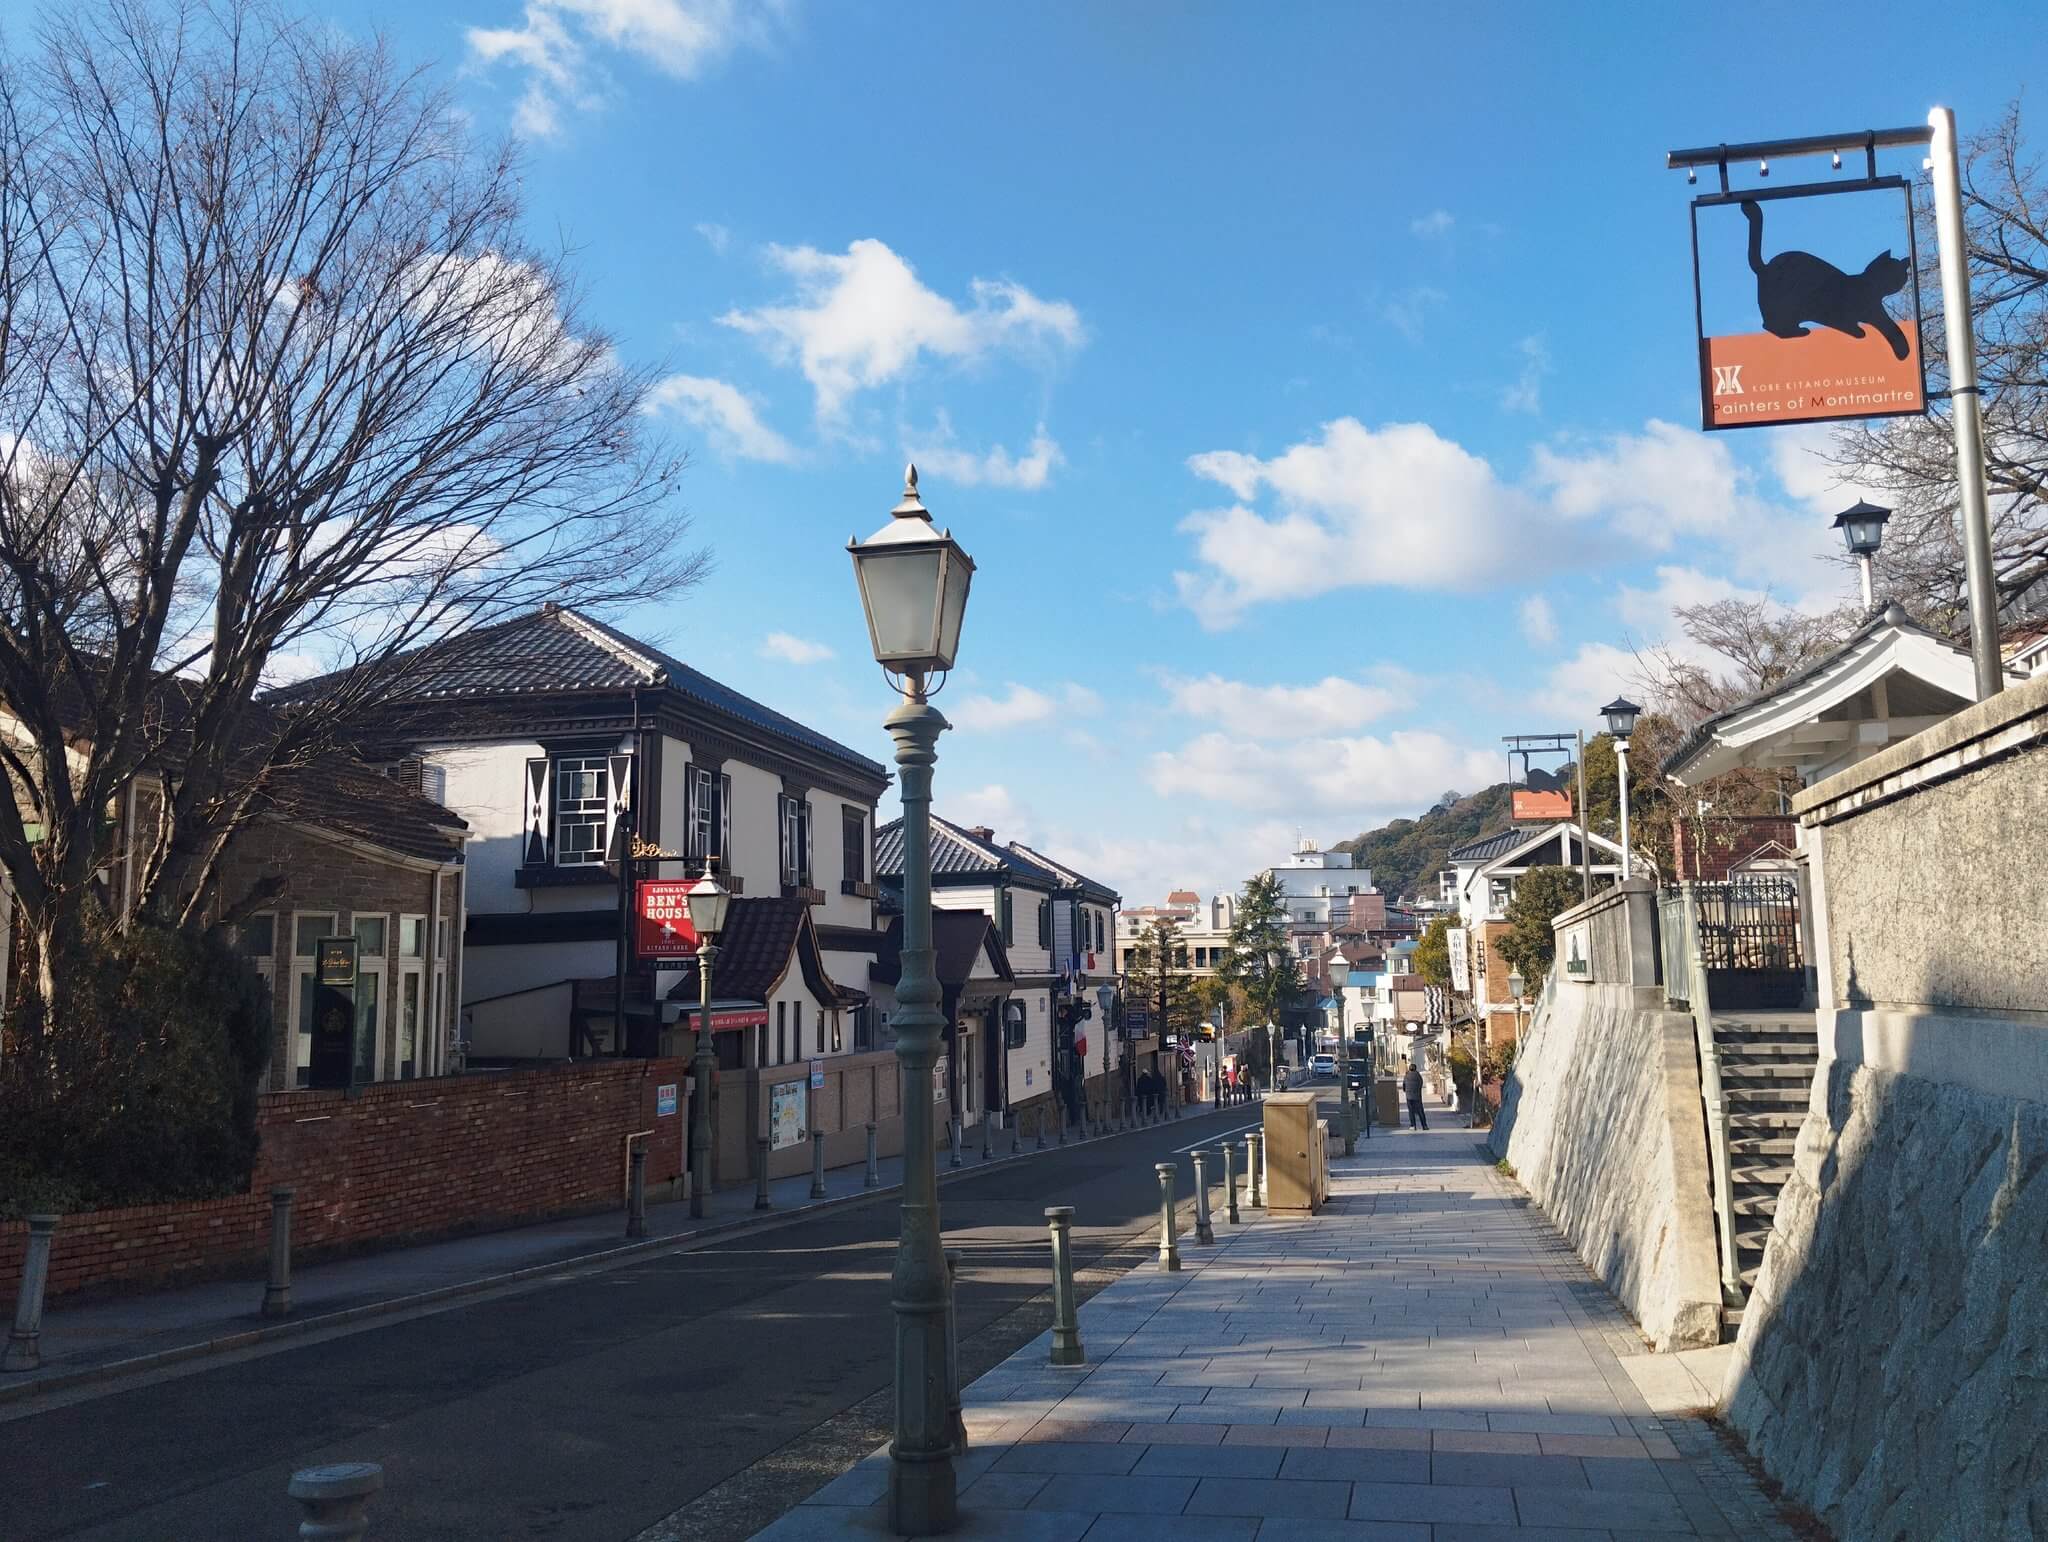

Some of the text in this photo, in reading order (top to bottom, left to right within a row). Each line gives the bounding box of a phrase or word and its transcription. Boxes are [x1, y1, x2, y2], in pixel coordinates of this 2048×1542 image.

[1752, 375, 1886, 393] KOBE KITANO MUSEUM
[1713, 389, 1914, 416] Painters of Montmartre
[647, 907, 691, 920] HOUSE
